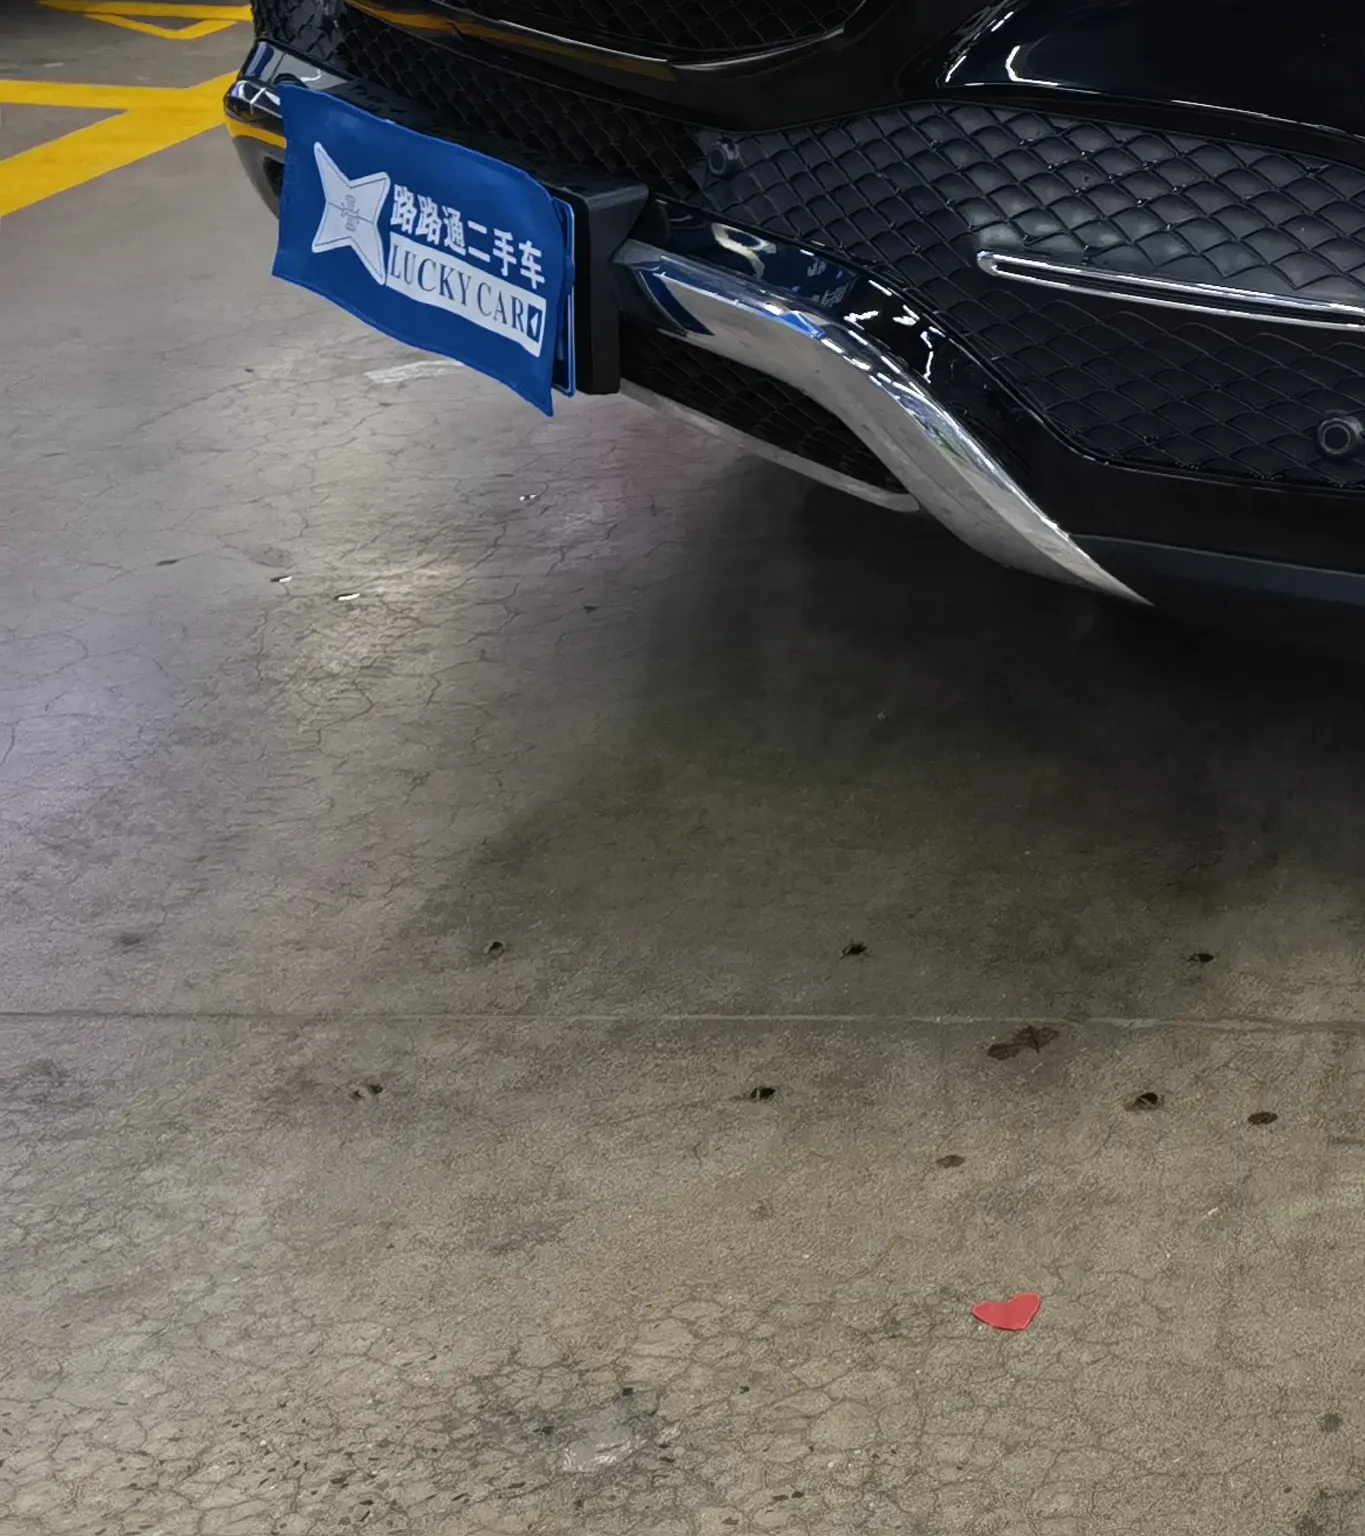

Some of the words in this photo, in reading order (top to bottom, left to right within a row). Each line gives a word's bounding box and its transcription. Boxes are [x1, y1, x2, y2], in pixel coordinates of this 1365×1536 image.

[390, 183, 546, 290] 路路通二手车
[390, 244, 472, 307] LUCKY
[477, 281, 525, 334] CAR
